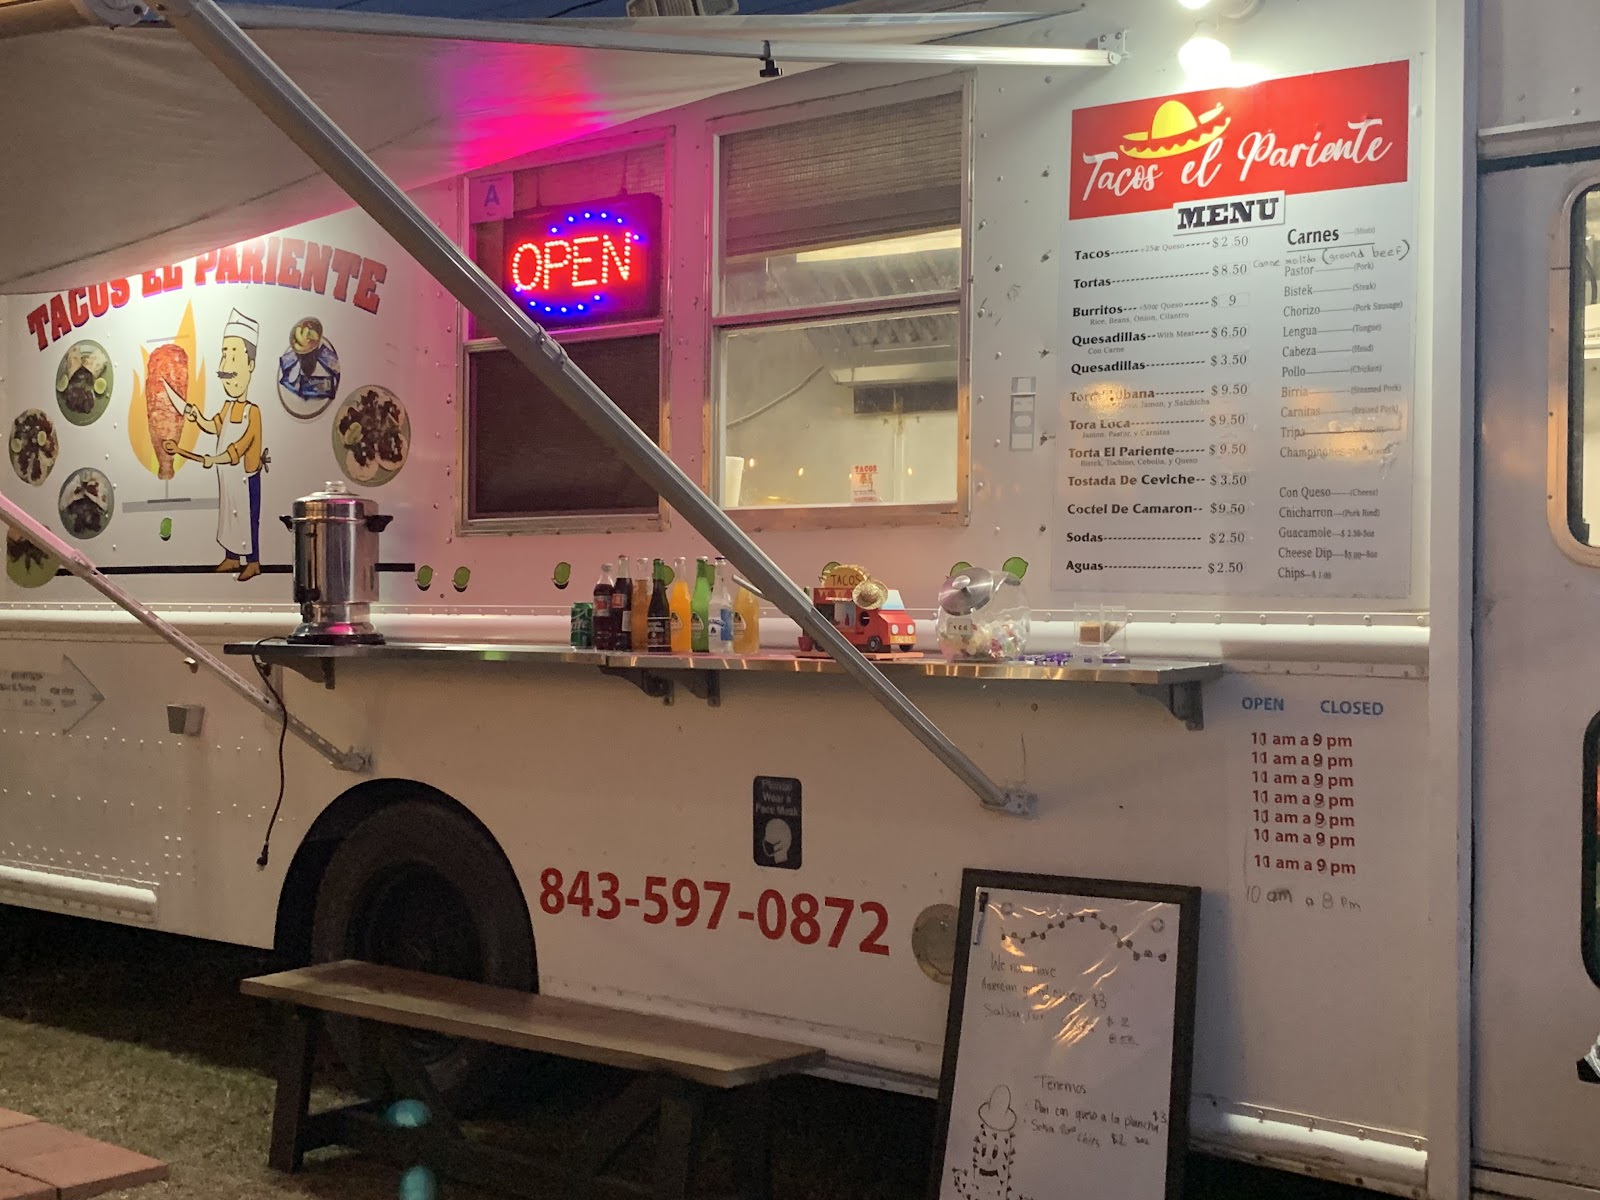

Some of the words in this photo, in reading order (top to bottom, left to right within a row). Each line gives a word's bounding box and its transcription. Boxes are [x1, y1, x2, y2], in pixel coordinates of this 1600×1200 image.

[1083, 151, 1163, 201] Tacos
[1181, 138, 1222, 188] el
[1238, 119, 1393, 182] Pariente
[484, 184, 499, 207] A
[1177, 197, 1279, 230] MENU
[1287, 228, 1341, 245] Carnes
[512, 232, 631, 291] OPEN
[1075, 250, 1110, 260] Tacos
[194, 236, 388, 315] PARIENTE
[1284, 265, 1315, 277] Pastor
[1074, 278, 1111, 289] Tortas
[1284, 285, 1314, 297] Bistek
[1073, 305, 1123, 317] Burritos
[1159, 311, 1189, 320] Cilantro
[1283, 306, 1321, 317] Chorizo
[1072, 332, 1147, 346] Quesadillas
[1283, 326, 1317, 339] Lengua
[1282, 346, 1316, 357] Cabeza
[1071, 360, 1146, 375] Quesadillas
[1282, 366, 1306, 377] Pollo
[1281, 387, 1309, 398] Birria
[1280, 406, 1321, 418] Carnitas
[1069, 420, 1096, 431] Tora
[1100, 419, 1130, 429] Loca
[1280, 426, 1305, 440] Tripa
[1069, 448, 1100, 459] Torta
[1104, 447, 1116, 457] El
[1119, 446, 1175, 457] Pariente
[1068, 475, 1116, 487] Tostada
[1120, 475, 1137, 486] De
[1141, 474, 1195, 486] Ceviche
[1280, 487, 1298, 498] Con
[1301, 487, 1331, 500] Queso
[1067, 503, 1108, 514] Coctel
[1111, 503, 1129, 514] De
[1132, 503, 1193, 514] Camaron
[1279, 507, 1333, 518] Chicharron
[1066, 532, 1103, 543] Sodas
[1278, 527, 1332, 538] Guacamole
[1278, 547, 1313, 559] Cheese
[1315, 547, 1333, 561] Dip
[1066, 560, 1104, 574] Aguas
[1278, 566, 1305, 581] Chips
[831, 574, 861, 587] TACOS
[1242, 697, 1285, 711] OPEN
[1320, 699, 1384, 716] CLOSED
[1272, 734, 1296, 746] am
[1300, 735, 1309, 747] a
[1327, 735, 1353, 750] pm
[1273, 753, 1297, 765] am
[1301, 754, 1310, 766] a
[1327, 756, 1353, 770] pm
[1273, 772, 1297, 785] am
[1301, 773, 1310, 785] a
[1328, 775, 1354, 790] pm
[1274, 791, 1298, 804] am
[1302, 793, 1310, 805] a
[1328, 795, 1354, 810] pm
[1274, 811, 1298, 824] am
[1302, 812, 1311, 824] a
[1329, 815, 1355, 829] pm
[1275, 830, 1299, 843] am
[1303, 832, 1311, 844] a
[1330, 835, 1355, 849] pm
[1276, 857, 1299, 870] am
[1303, 859, 1312, 871] a
[1330, 861, 1356, 876] pm
[1267, 888, 1293, 903] am
[539, 867, 890, 956] 843-597-0872
[1034, 1075, 1087, 1094] Tenemos
